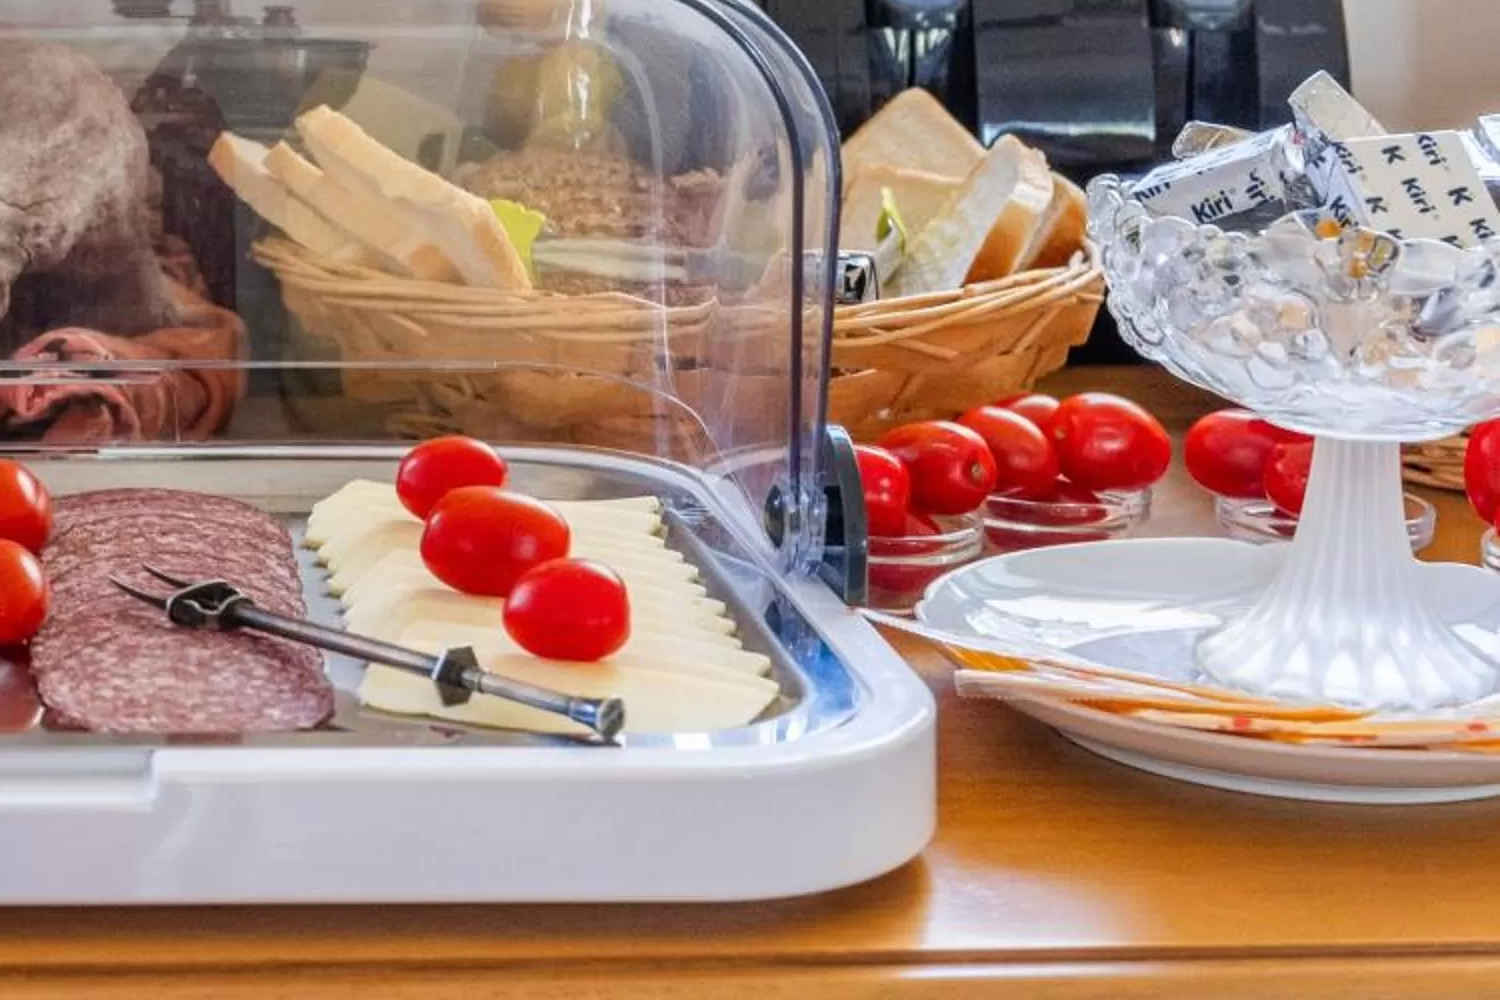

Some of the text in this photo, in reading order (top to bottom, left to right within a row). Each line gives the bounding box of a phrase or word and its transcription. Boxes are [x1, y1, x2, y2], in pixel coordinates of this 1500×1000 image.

[1191, 189, 1233, 224] Kiri
[1365, 196, 1388, 213] K
[1401, 177, 1436, 213] Kiri
[1447, 186, 1473, 206] K
